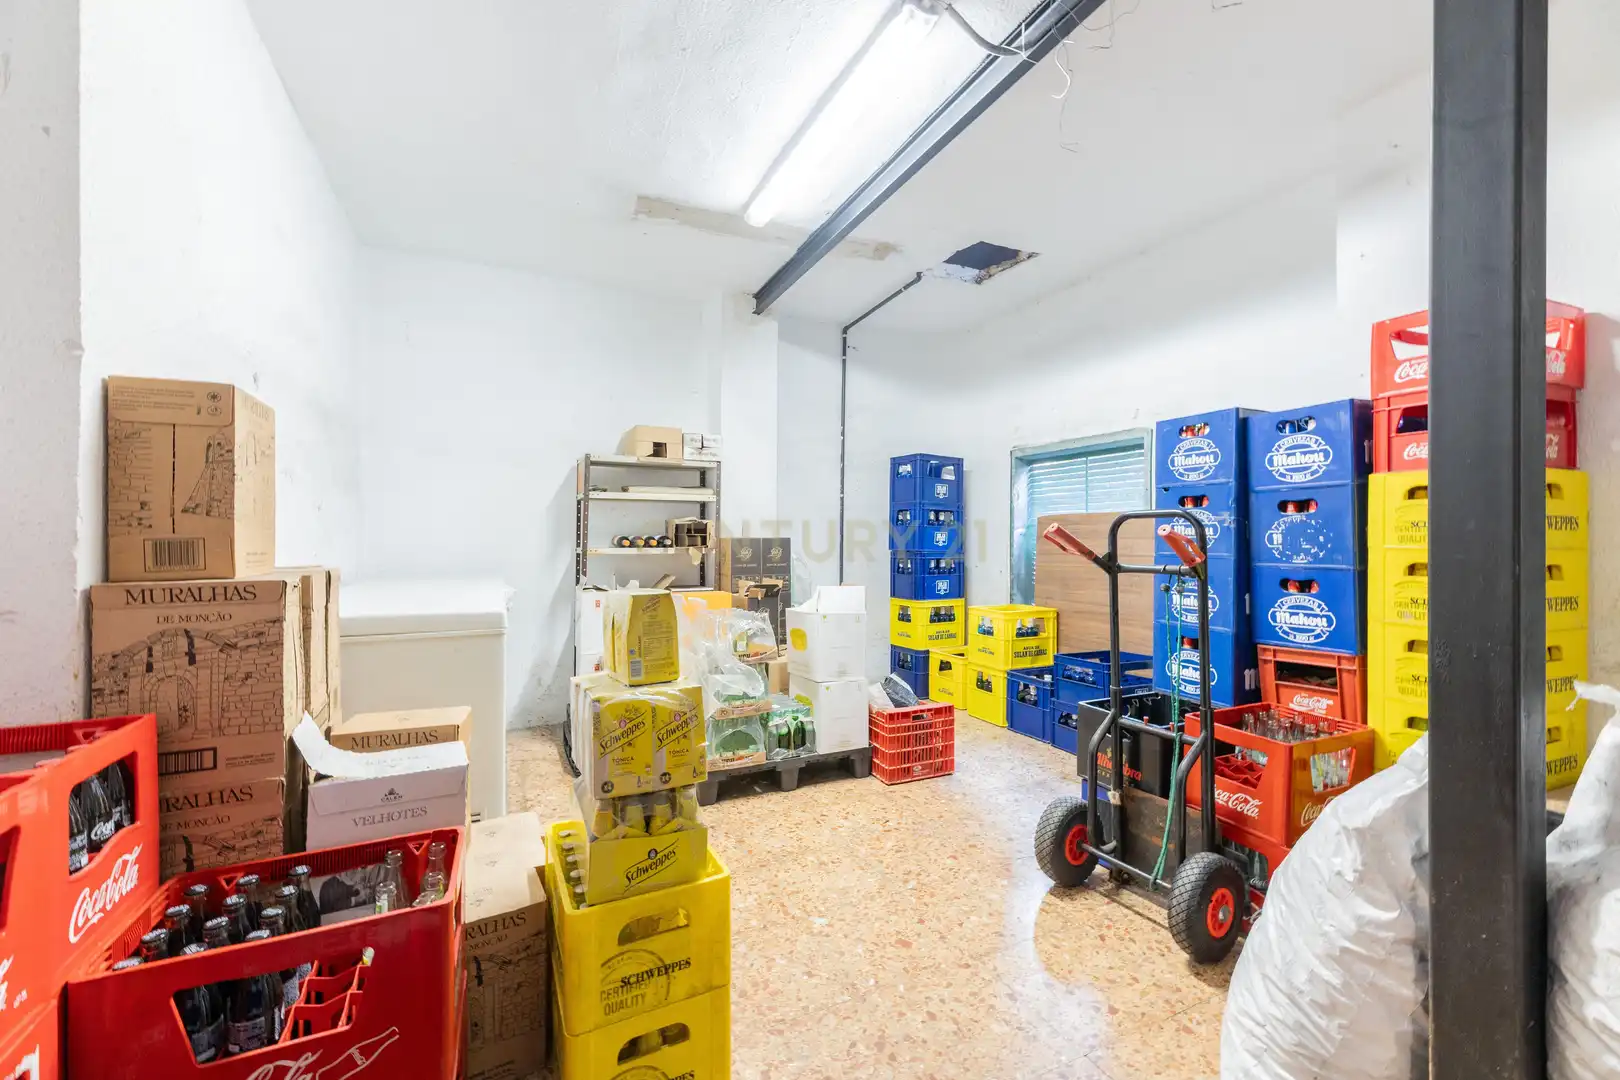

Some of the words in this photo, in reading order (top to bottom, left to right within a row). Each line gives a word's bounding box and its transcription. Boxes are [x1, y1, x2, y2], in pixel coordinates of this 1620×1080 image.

[1174, 453, 1214, 467] Mahou
[1273, 452, 1325, 467] Mahou
[1546, 515, 1579, 531] WEPPES
[125, 584, 257, 606] MURALHAS
[1546, 595, 1579, 612] WEPPES
[156, 614, 174, 624] DE
[178, 611, 232, 624] MONÇÃO
[1275, 611, 1328, 627] Mahou
[351, 729, 438, 749] MURALHAS
[600, 719, 646, 756] Schweppes
[656, 714, 699, 748] Schweppes
[1546, 754, 1578, 776] WEPPES
[160, 785, 253, 814] RALHAS
[351, 806, 428, 827] VELHOTES
[625, 848, 677, 886] Schweppes
[465, 911, 527, 941] RALHAS
[620, 957, 692, 989] SCHWEPPES
[604, 992, 646, 1017] QUALITY
